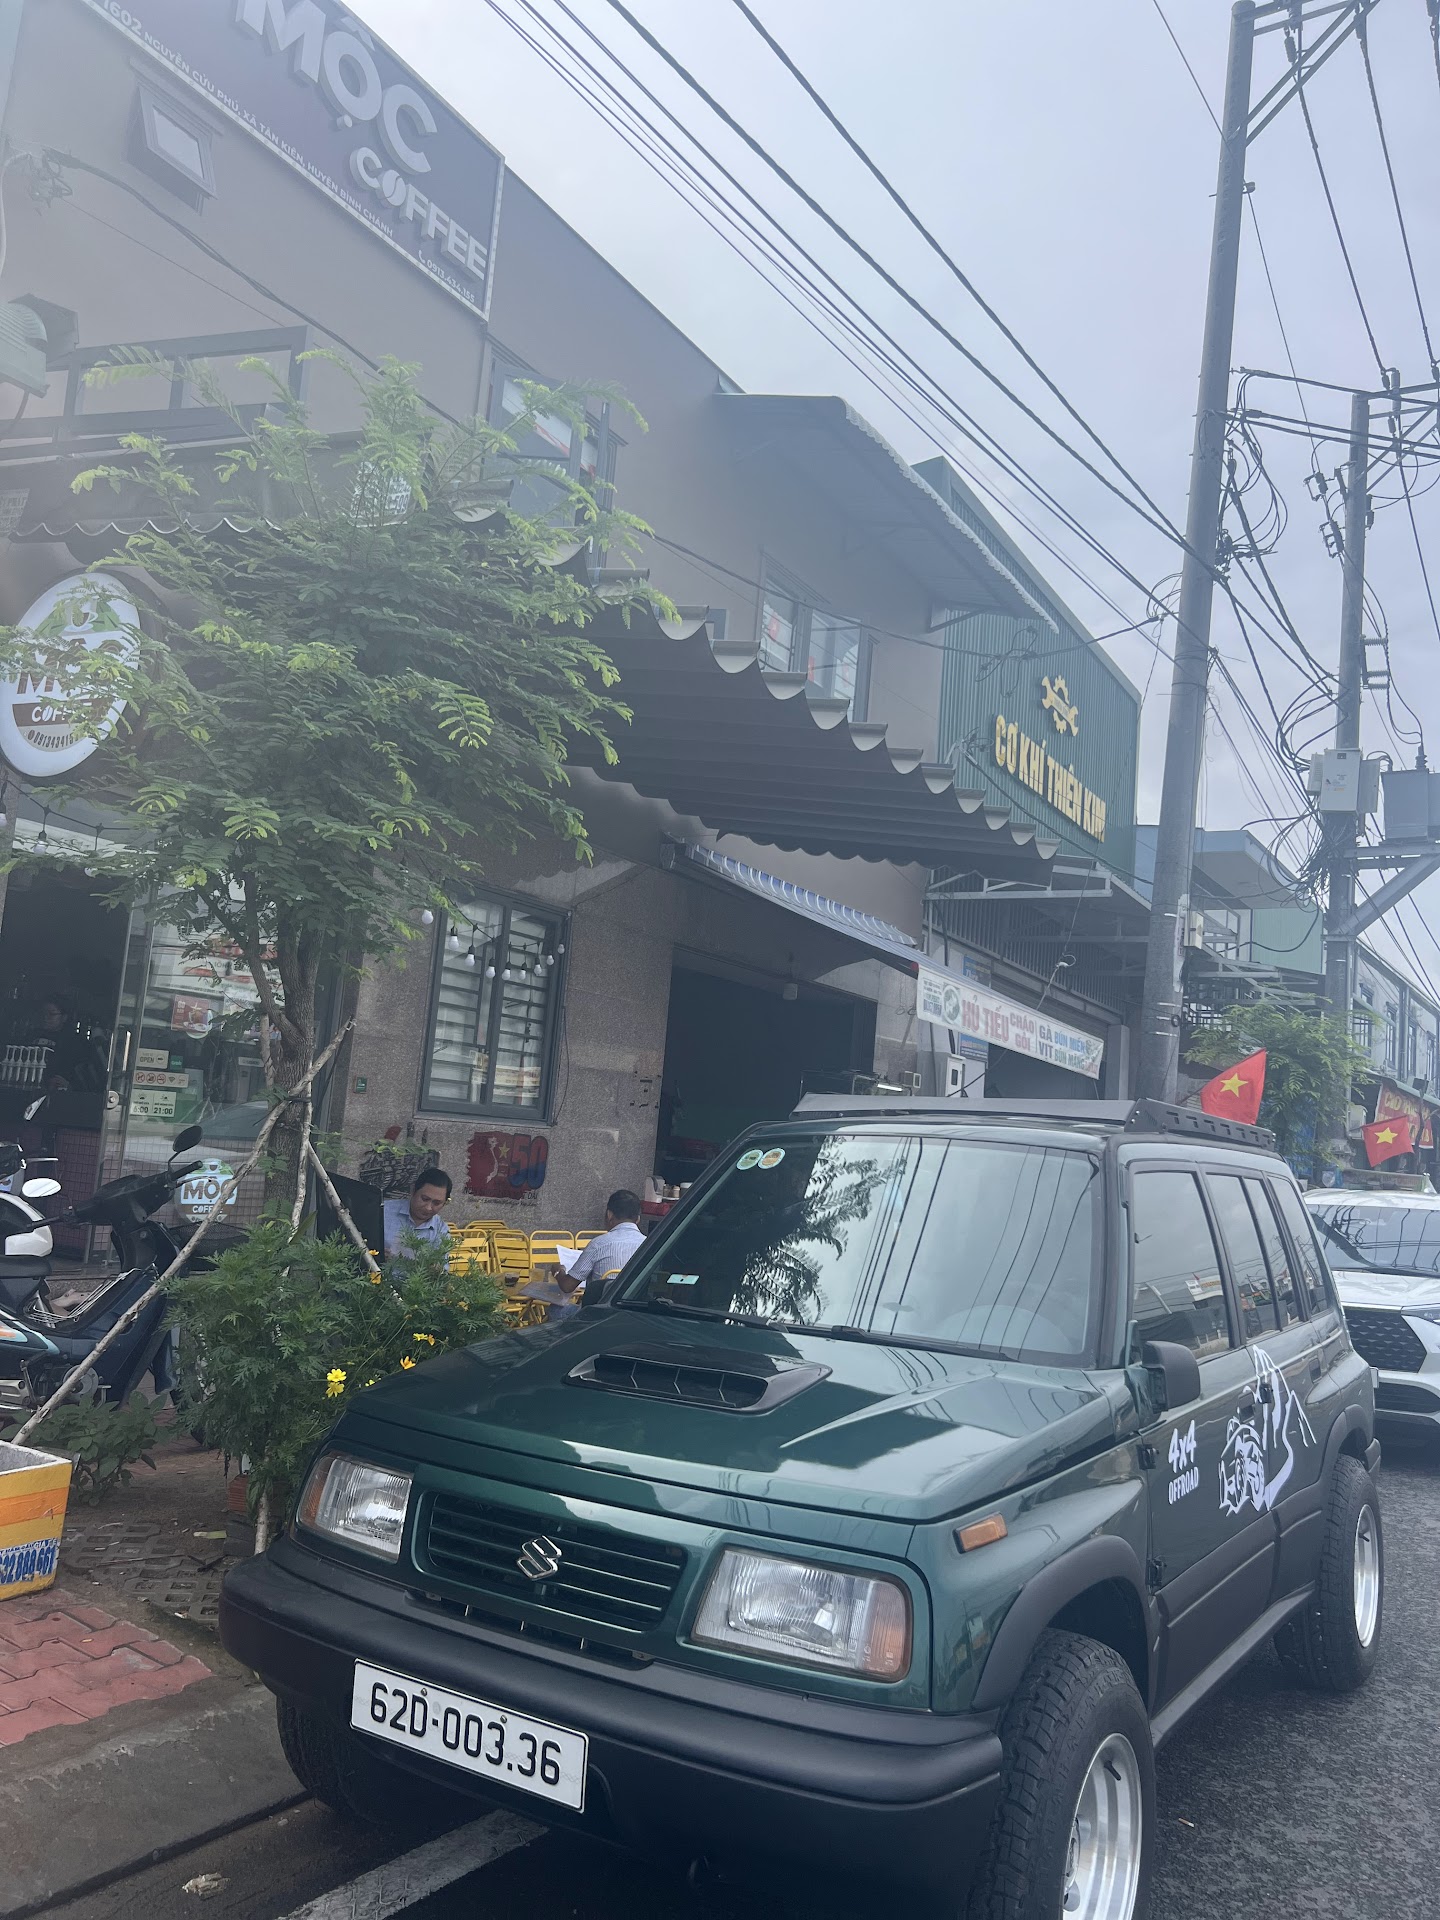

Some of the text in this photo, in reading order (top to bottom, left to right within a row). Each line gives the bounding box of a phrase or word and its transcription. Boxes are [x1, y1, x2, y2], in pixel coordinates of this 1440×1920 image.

[104, 0, 142, 35] 1602
[144, 31, 190, 73] NGUYỄN
[236, 0, 437, 173] MỘC
[351, 146, 489, 281] COFFEE
[995, 714, 1106, 843] CƠ KHÍ THIÊN KIM
[1038, 1040, 1053, 1060] VỊT
[1039, 1024, 1053, 1043] GÀ
[153, 1107, 173, 1115] 21:00
[1168, 1420, 1197, 1473] 4x4
[1168, 1467, 1199, 1504] OFFROAD
[370, 1681, 561, 1786] 62D-003.36
